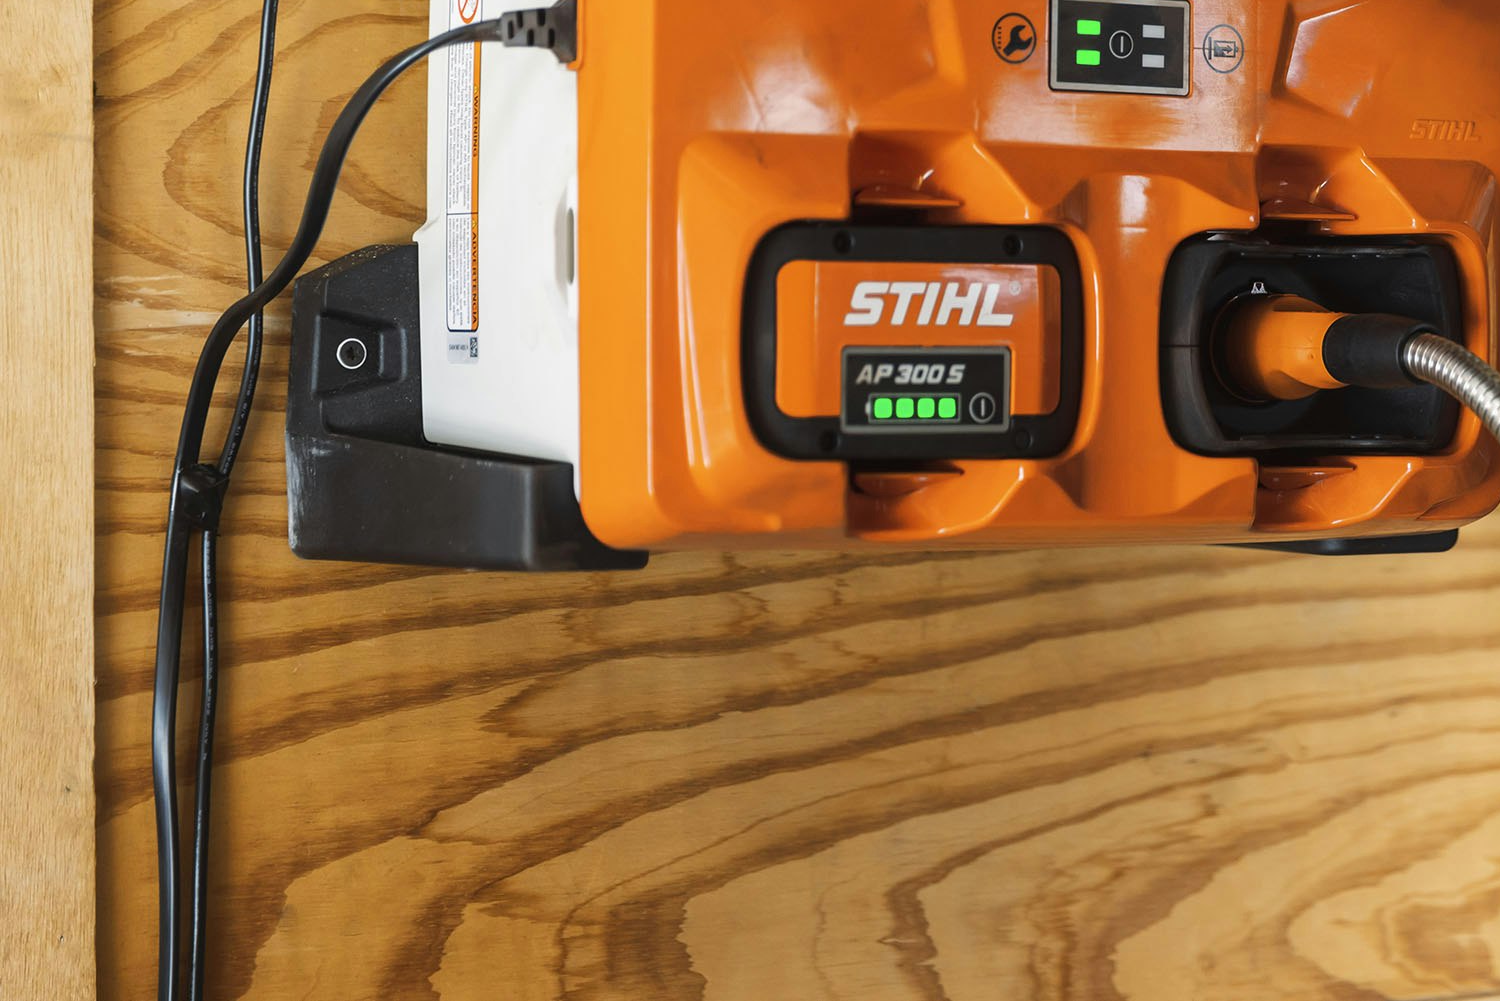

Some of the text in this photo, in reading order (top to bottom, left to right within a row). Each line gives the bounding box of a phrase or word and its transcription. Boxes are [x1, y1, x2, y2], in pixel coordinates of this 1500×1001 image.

[1408, 118, 1480, 141] STIHL
[856, 364, 966, 385] AP 300 S
